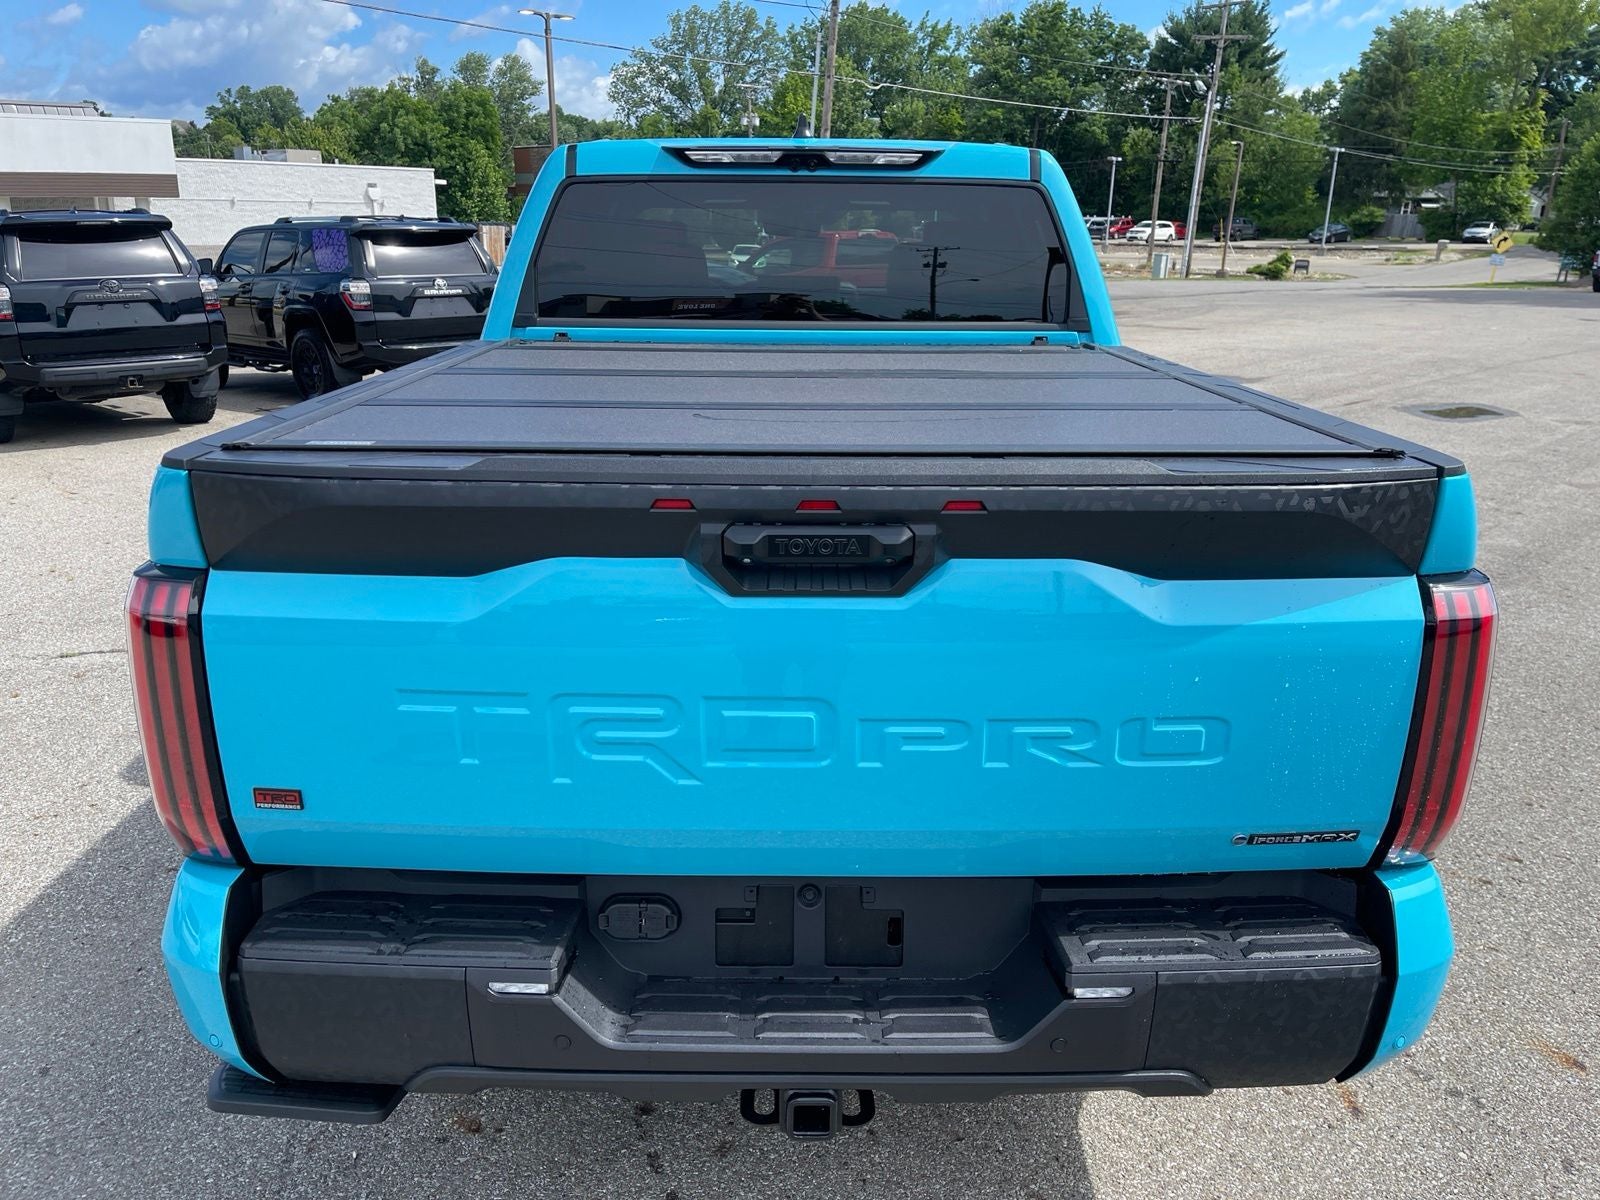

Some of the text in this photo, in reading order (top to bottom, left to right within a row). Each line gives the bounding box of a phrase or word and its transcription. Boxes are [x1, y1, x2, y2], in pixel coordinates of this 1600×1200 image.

[775, 538, 863, 555] TOYOTA
[395, 688, 1233, 786] TRD PRO
[256, 792, 298, 803] TRD
[256, 802, 302, 810] PERFORMANCE
